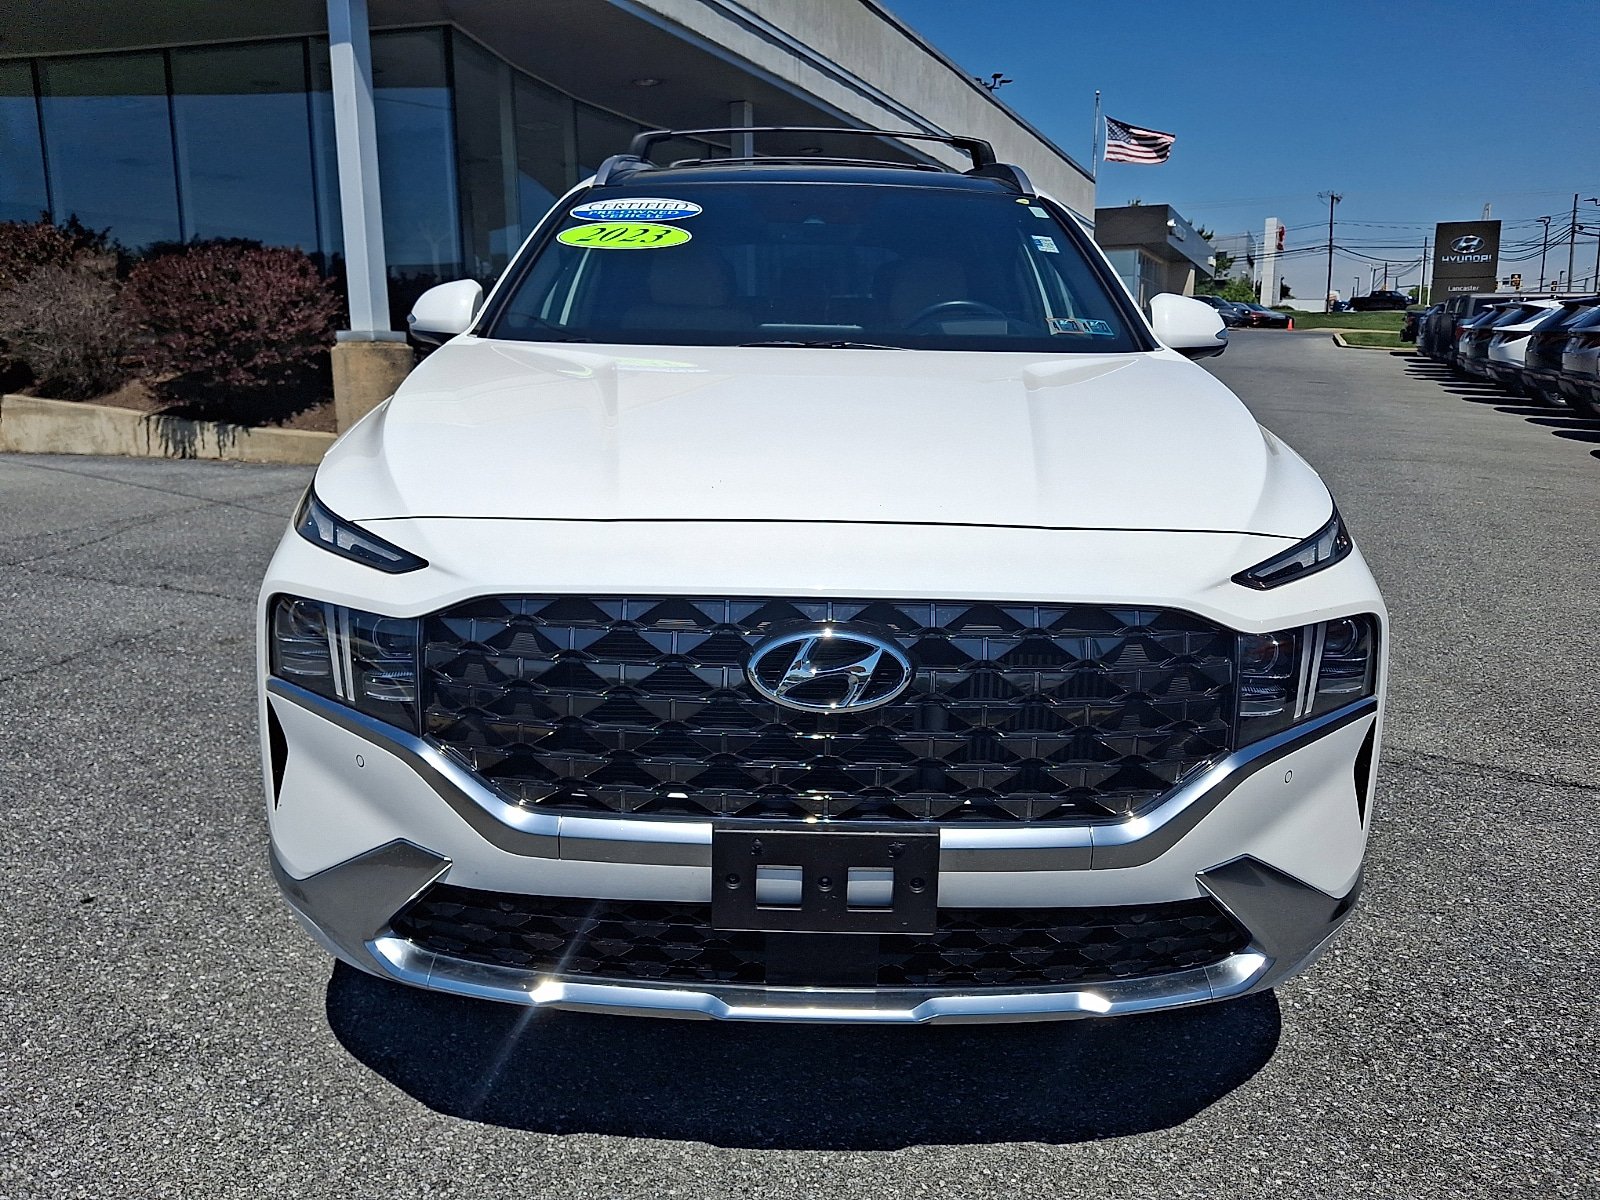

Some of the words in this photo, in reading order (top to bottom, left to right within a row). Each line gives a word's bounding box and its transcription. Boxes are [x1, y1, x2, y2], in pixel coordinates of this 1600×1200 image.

[589, 202, 689, 210] CERTIFIED
[576, 227, 672, 242] 2023
[1441, 254, 1492, 263] HYUNDAI
